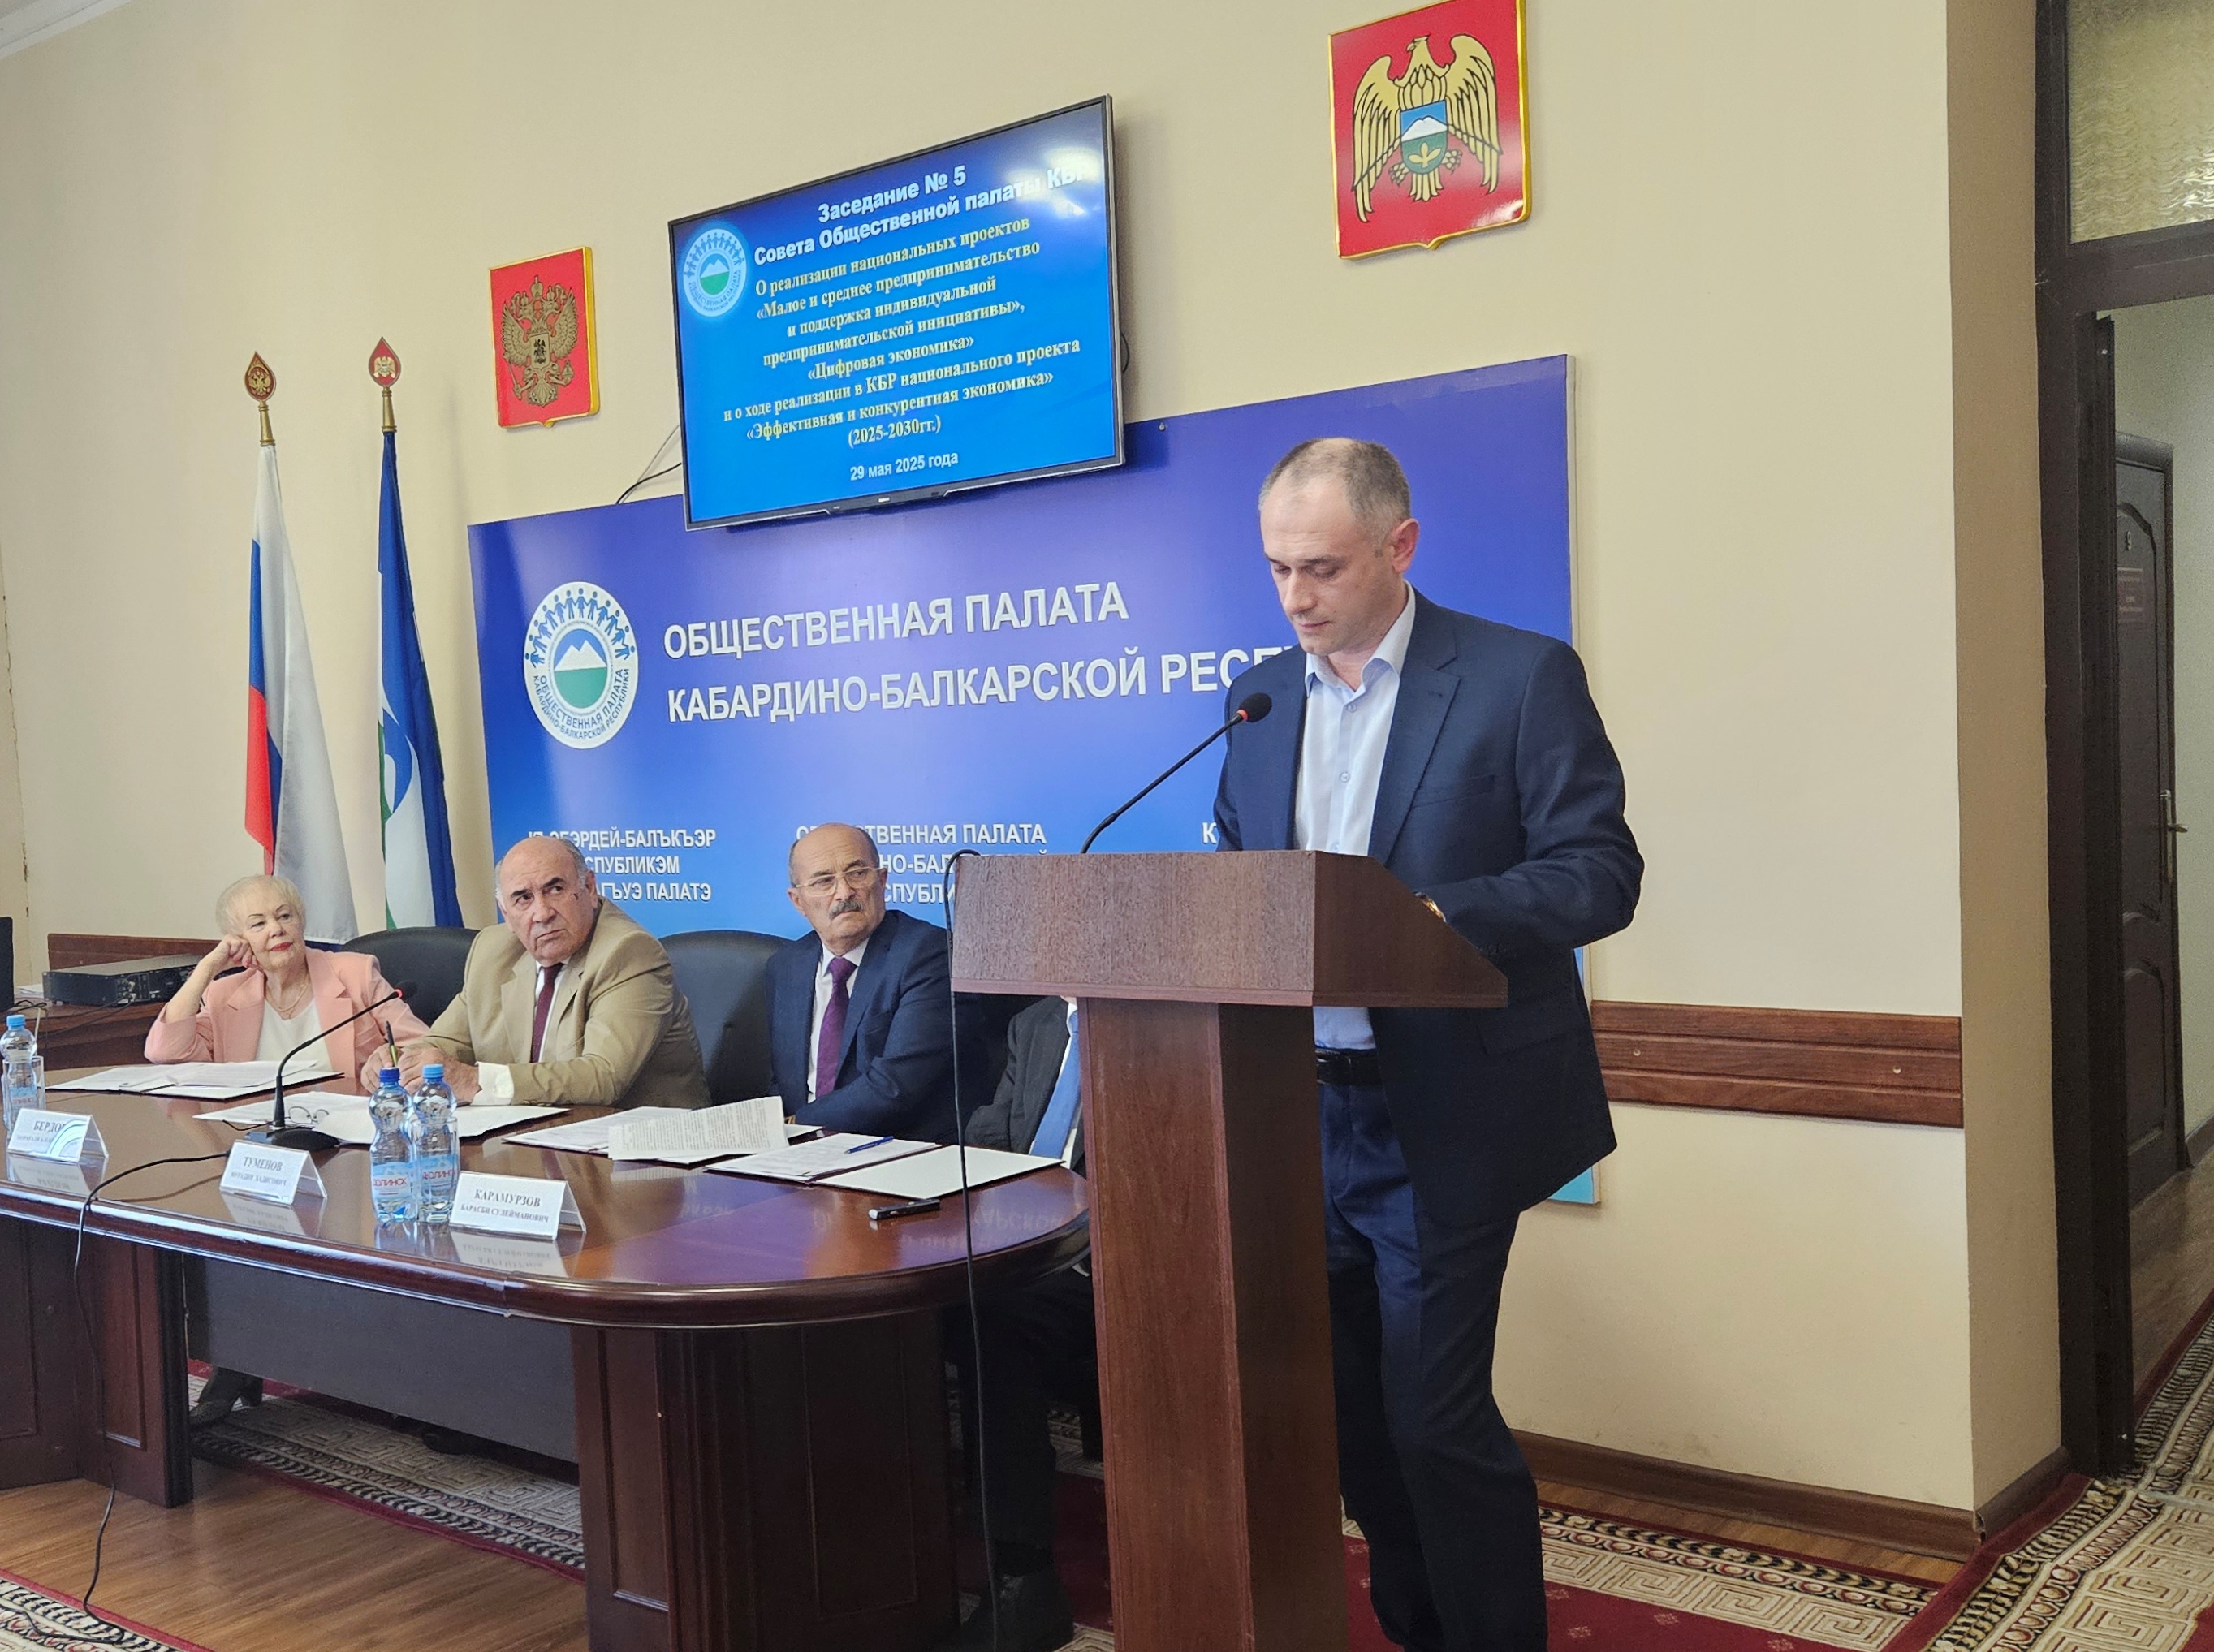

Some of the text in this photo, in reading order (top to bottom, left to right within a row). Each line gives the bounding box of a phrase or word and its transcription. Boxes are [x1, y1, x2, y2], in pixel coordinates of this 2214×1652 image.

[754, 238, 814, 265] Совета
[819, 195, 960, 248] Общественной
[965, 178, 1041, 211] палаты
[818, 166, 966, 223] Заседание № 5
[756, 279, 767, 296] О
[770, 264, 847, 297] реализации
[851, 237, 956, 274] национальных
[960, 218, 1030, 248] проектов
[757, 242, 1040, 319] «Малое и среднее предпринимательство
[763, 300, 1025, 368] предпринимательской инициативы»,
[788, 275, 996, 338] и поддержка индивидуальной
[723, 339, 1080, 421] и о ходе реализации в КБР национального проекта
[808, 336, 974, 381] «Цифровая экономика»
[747, 373, 1054, 440] «Эффективная и конкурентная экономика»
[848, 415, 941, 449] (2025-2030гг.)
[850, 452, 959, 481] 29 мая 2025 года
[664, 598, 953, 658] ОБЩЕСТВЕННАЯ
[965, 581, 1129, 632] ПАЛАТА
[533, 668, 629, 739] КАБАРДИНО-БАЛКАРСКОЙ РЕСПУБЛИКИ
[540, 668, 624, 729] ОБЩЕСТВЕННАЯ ПАЛАТА
[667, 646, 1146, 722] КАБАРДИНО-БАЛКАРСКОЙ
[963, 823, 1047, 844] ПАЛАТА
[646, 882, 712, 902] ПАЛАТЭ
[244, 1156, 283, 1172] ТУМЕНОВ
[474, 1189, 541, 1207] КАРАМУРЗОВ
